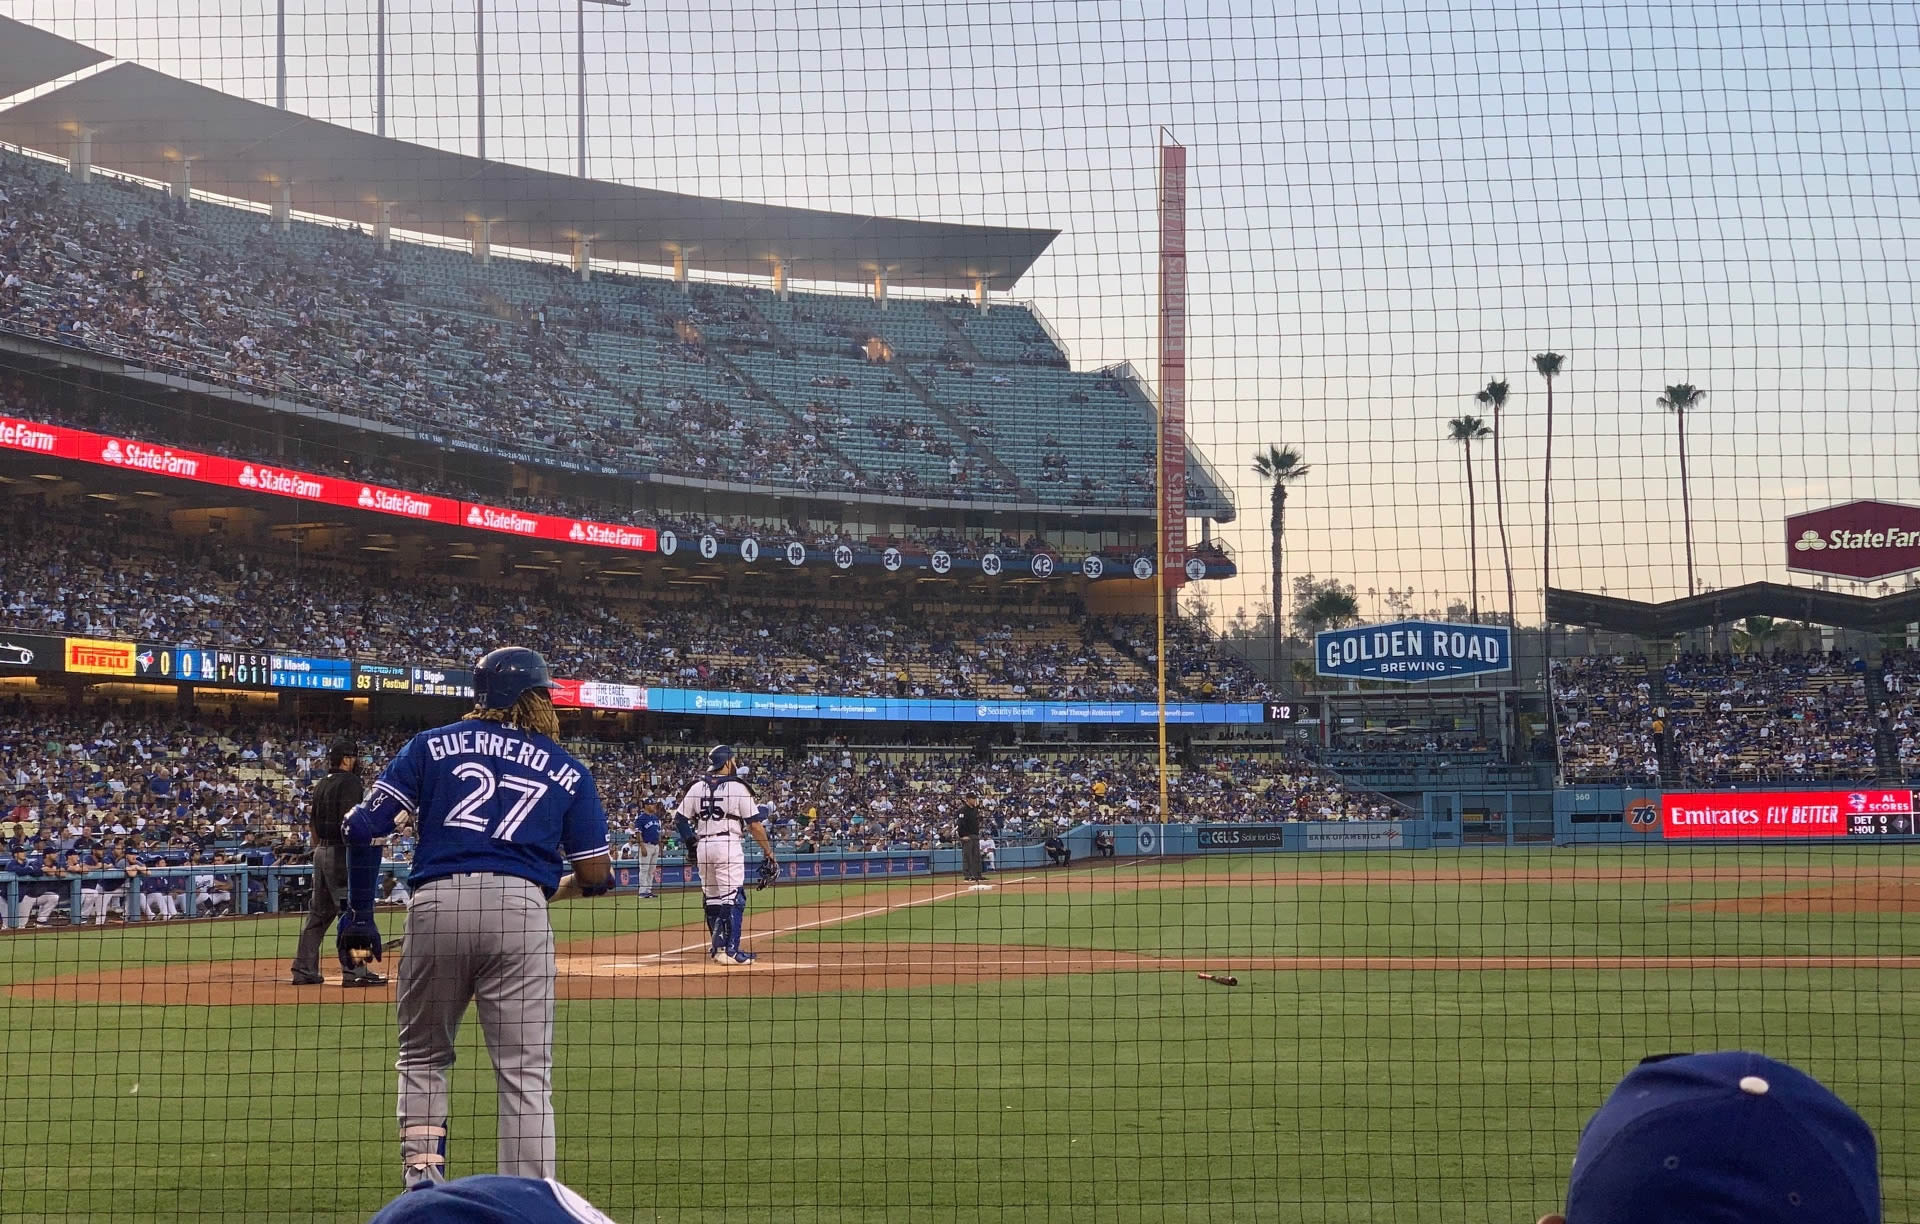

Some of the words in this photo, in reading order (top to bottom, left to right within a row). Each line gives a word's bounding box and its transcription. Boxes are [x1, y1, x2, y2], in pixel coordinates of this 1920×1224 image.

[1164, 440, 1184, 465] FLY
[1165, 472, 1184, 569] Emirates
[1829, 528, 1920, 549] StateFar
[790, 547, 801, 561] 19
[837, 551, 850, 564] 20
[885, 553, 899, 567] 24
[934, 555, 949, 569] 32
[984, 558, 999, 571] 39
[1034, 558, 1049, 572] 42
[1085, 561, 1101, 574] 53
[1326, 630, 1422, 668] GOLDEN
[1434, 630, 1500, 663] ROAD
[72, 646, 129, 668] PIRELLI
[160, 651, 170, 675] 0
[250, 656, 256, 665] S
[273, 658, 281, 669] 18
[183, 653, 192, 677] 0
[221, 665, 226, 679] 1
[1381, 662, 1445, 673] BREWING
[251, 667, 256, 684] 1
[262, 667, 266, 684] 1
[357, 675, 371, 689] 93
[383, 678, 410, 690] Fastball
[597, 684, 607, 695] THE
[609, 685, 624, 696] EAGLE
[597, 696, 608, 705] HAS
[988, 707, 1012, 717] Security
[1271, 706, 1290, 719] 7:12
[427, 731, 550, 772] GUERRERO
[548, 763, 582, 795] JR.
[443, 762, 549, 842] 27
[1882, 794, 1895, 802] AL
[700, 798, 724, 821] 55
[1869, 803, 1909, 811] SCORES
[1631, 805, 1657, 825] 76
[1671, 806, 1760, 825] Emirates
[1767, 806, 1788, 824] FLY
[1792, 806, 1838, 824] BETTER
[1854, 816, 1873, 824] DET
[1880, 816, 1887, 824] 0
[1854, 826, 1875, 834] HOU
[1880, 826, 1888, 834] 3
[1211, 831, 1240, 844] CELLS
